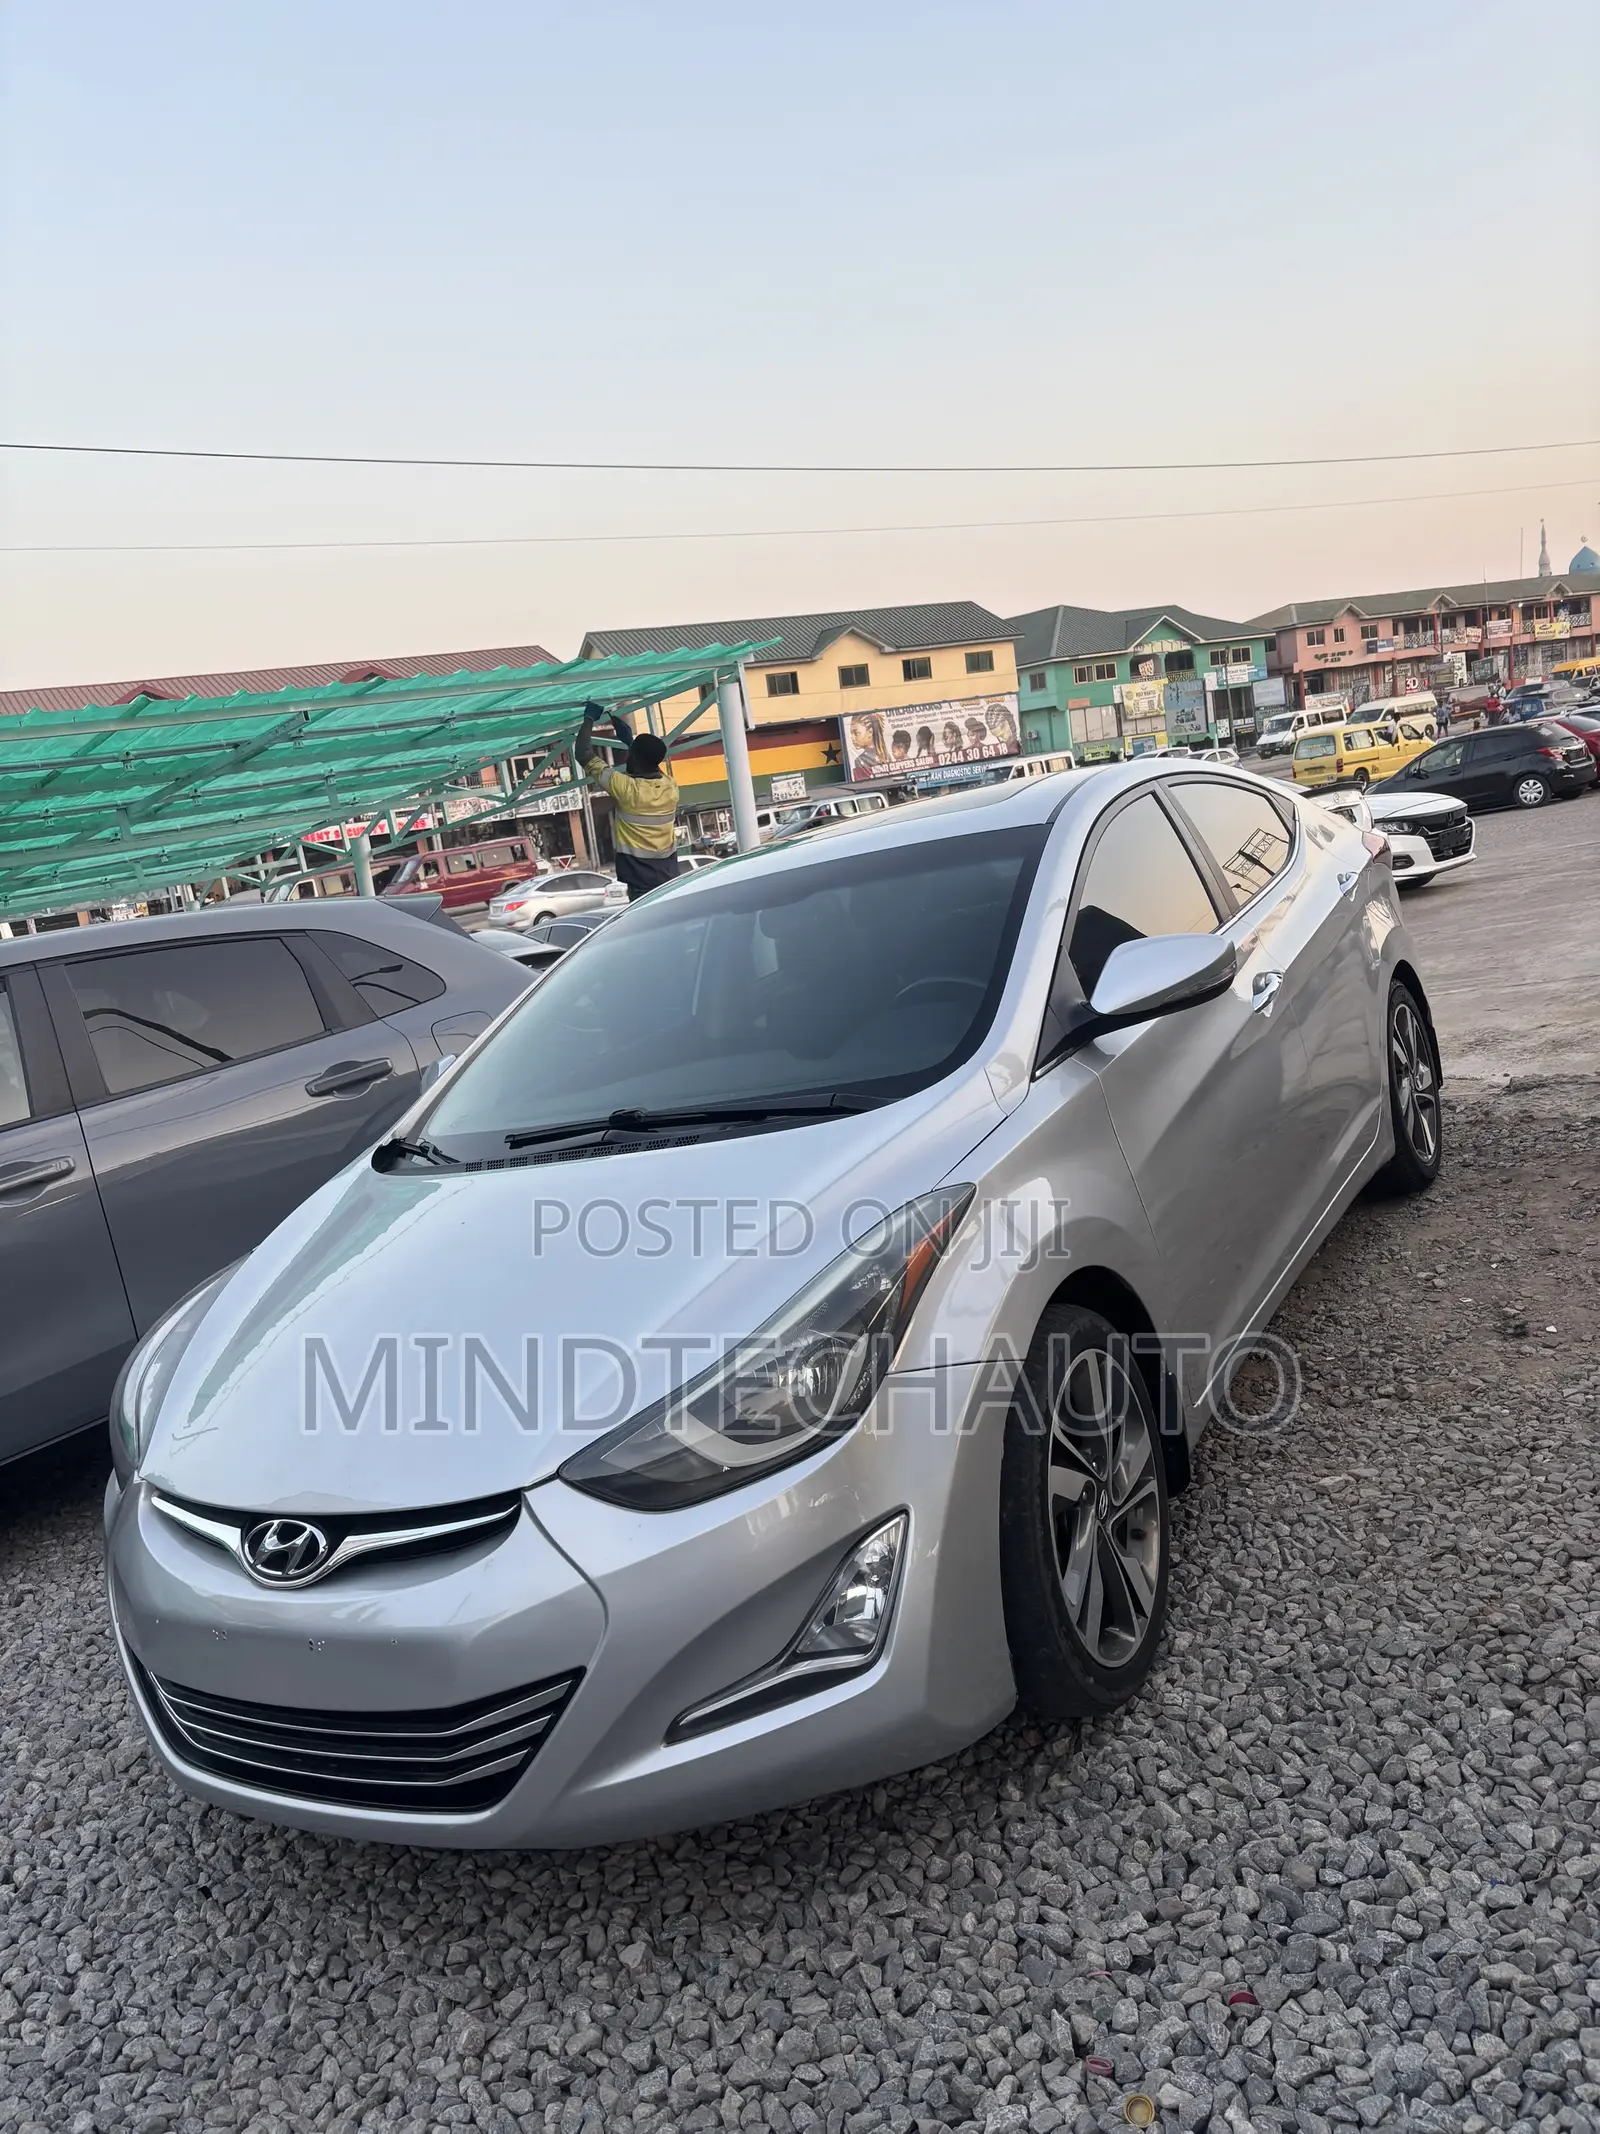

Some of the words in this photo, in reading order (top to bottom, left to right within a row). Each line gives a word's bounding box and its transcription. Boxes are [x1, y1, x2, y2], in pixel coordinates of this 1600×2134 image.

[938, 751, 965, 766] 0244
[966, 747, 980, 761] 30
[982, 745, 996, 758] 64
[997, 743, 1009, 754] 18
[889, 760, 915, 772] CLIPPERS
[915, 756, 934, 767] SALON
[943, 766, 971, 779] DIAGNOSTIC
[334, 824, 386, 839] SCURY
